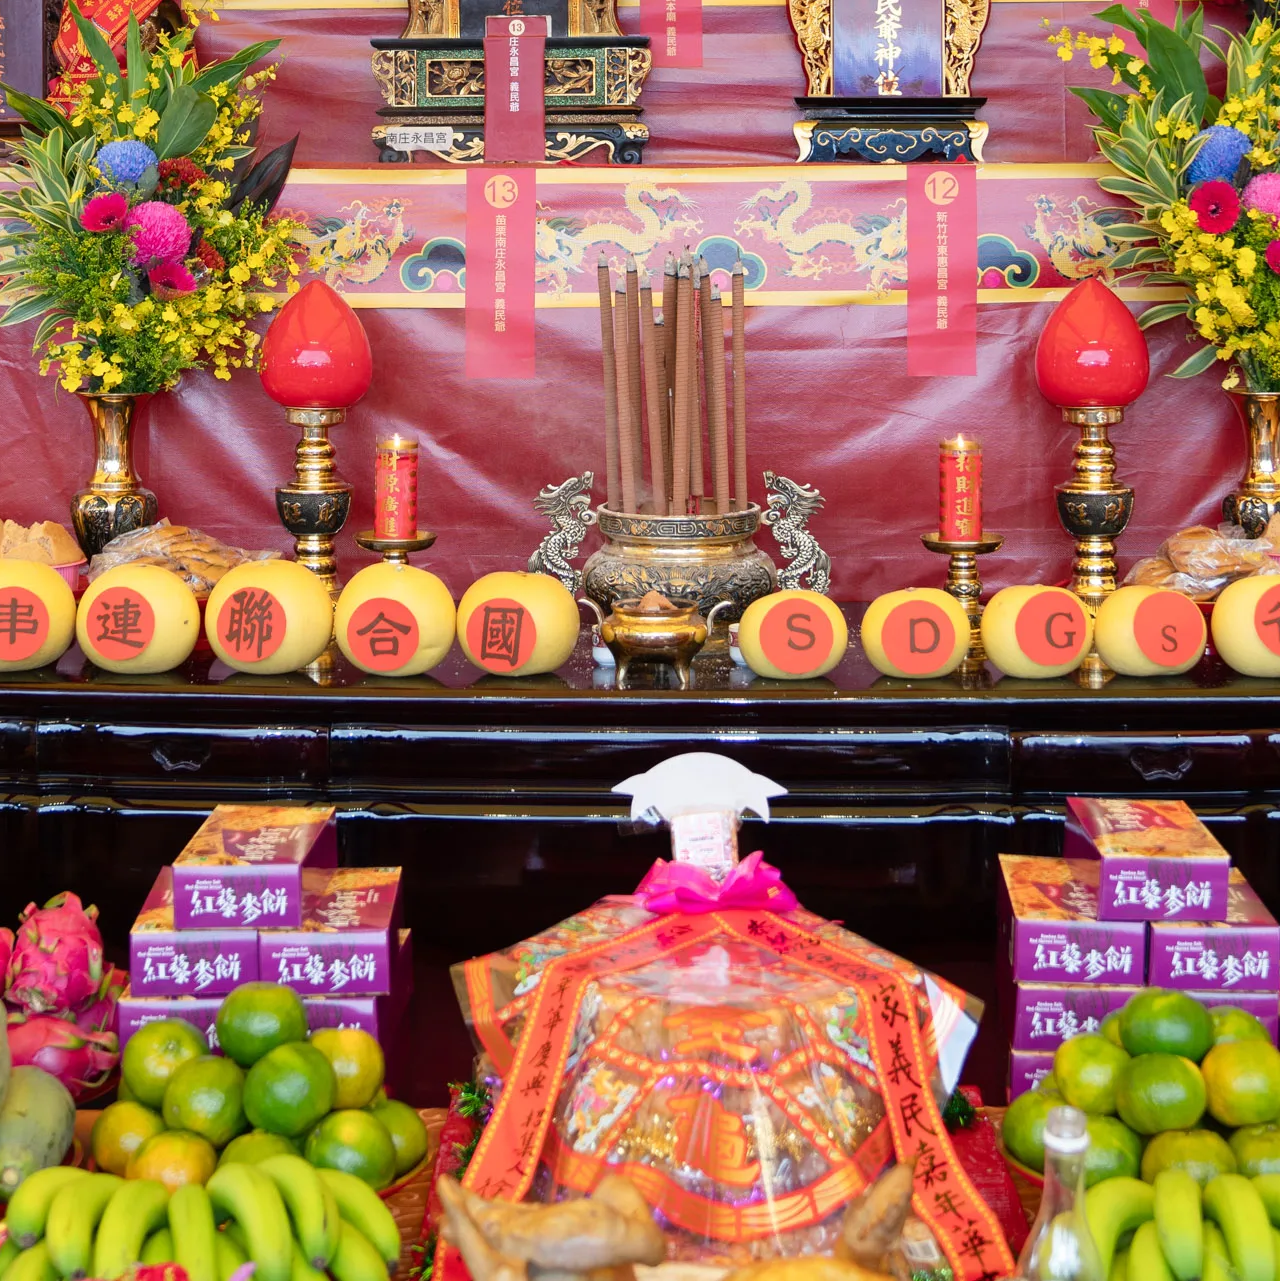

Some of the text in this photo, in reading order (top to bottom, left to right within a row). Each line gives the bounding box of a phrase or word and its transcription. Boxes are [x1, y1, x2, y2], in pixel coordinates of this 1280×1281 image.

[486, 180, 516, 203] 13
[927, 177, 956, 200] 12
[95, 603, 147, 648] 連
[227, 589, 275, 662] 聯
[358, 613, 413, 658] 合
[481, 606, 526, 666] 國
[784, 612, 818, 651] S
[909, 618, 941, 655] D
[1044, 612, 1076, 650] G
